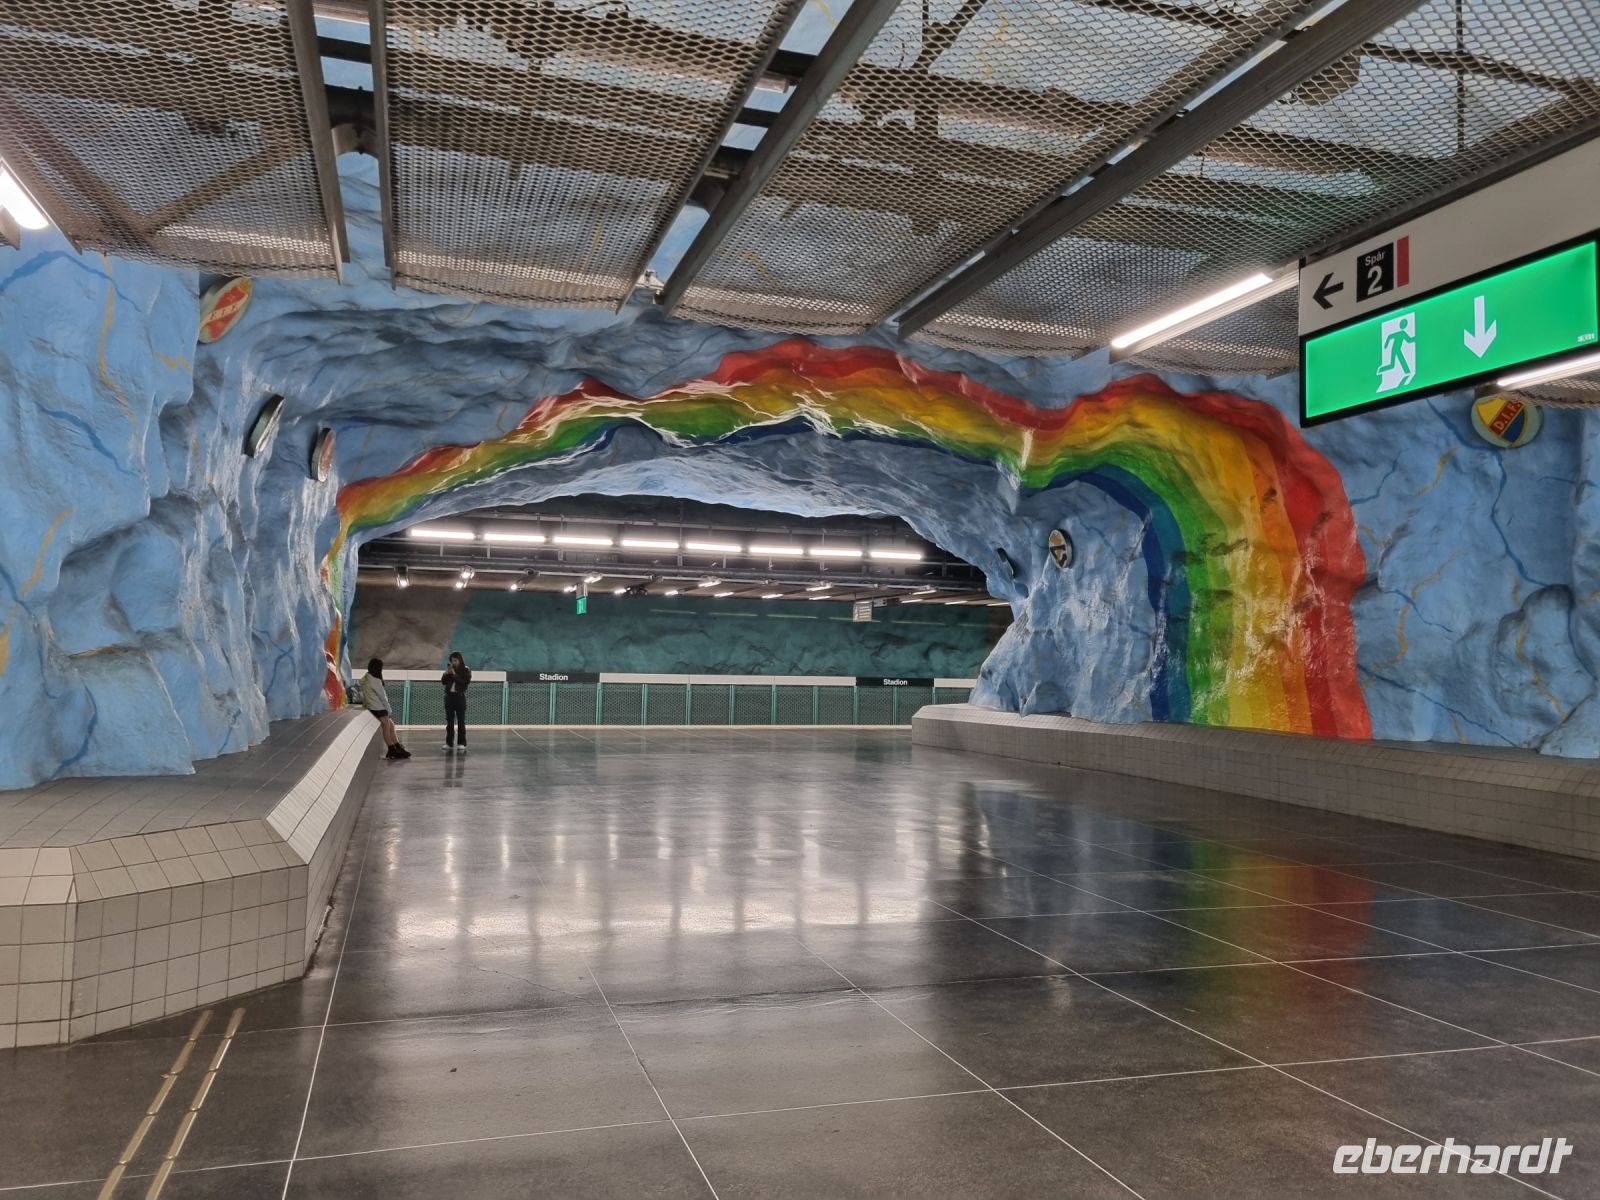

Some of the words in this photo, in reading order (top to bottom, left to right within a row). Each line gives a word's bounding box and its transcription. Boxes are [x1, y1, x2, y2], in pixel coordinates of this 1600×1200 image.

[1364, 250, 1386, 267] Spår
[1367, 265, 1383, 295] 2
[539, 672, 569, 681] Stadion
[883, 678, 908, 686] Stadion
